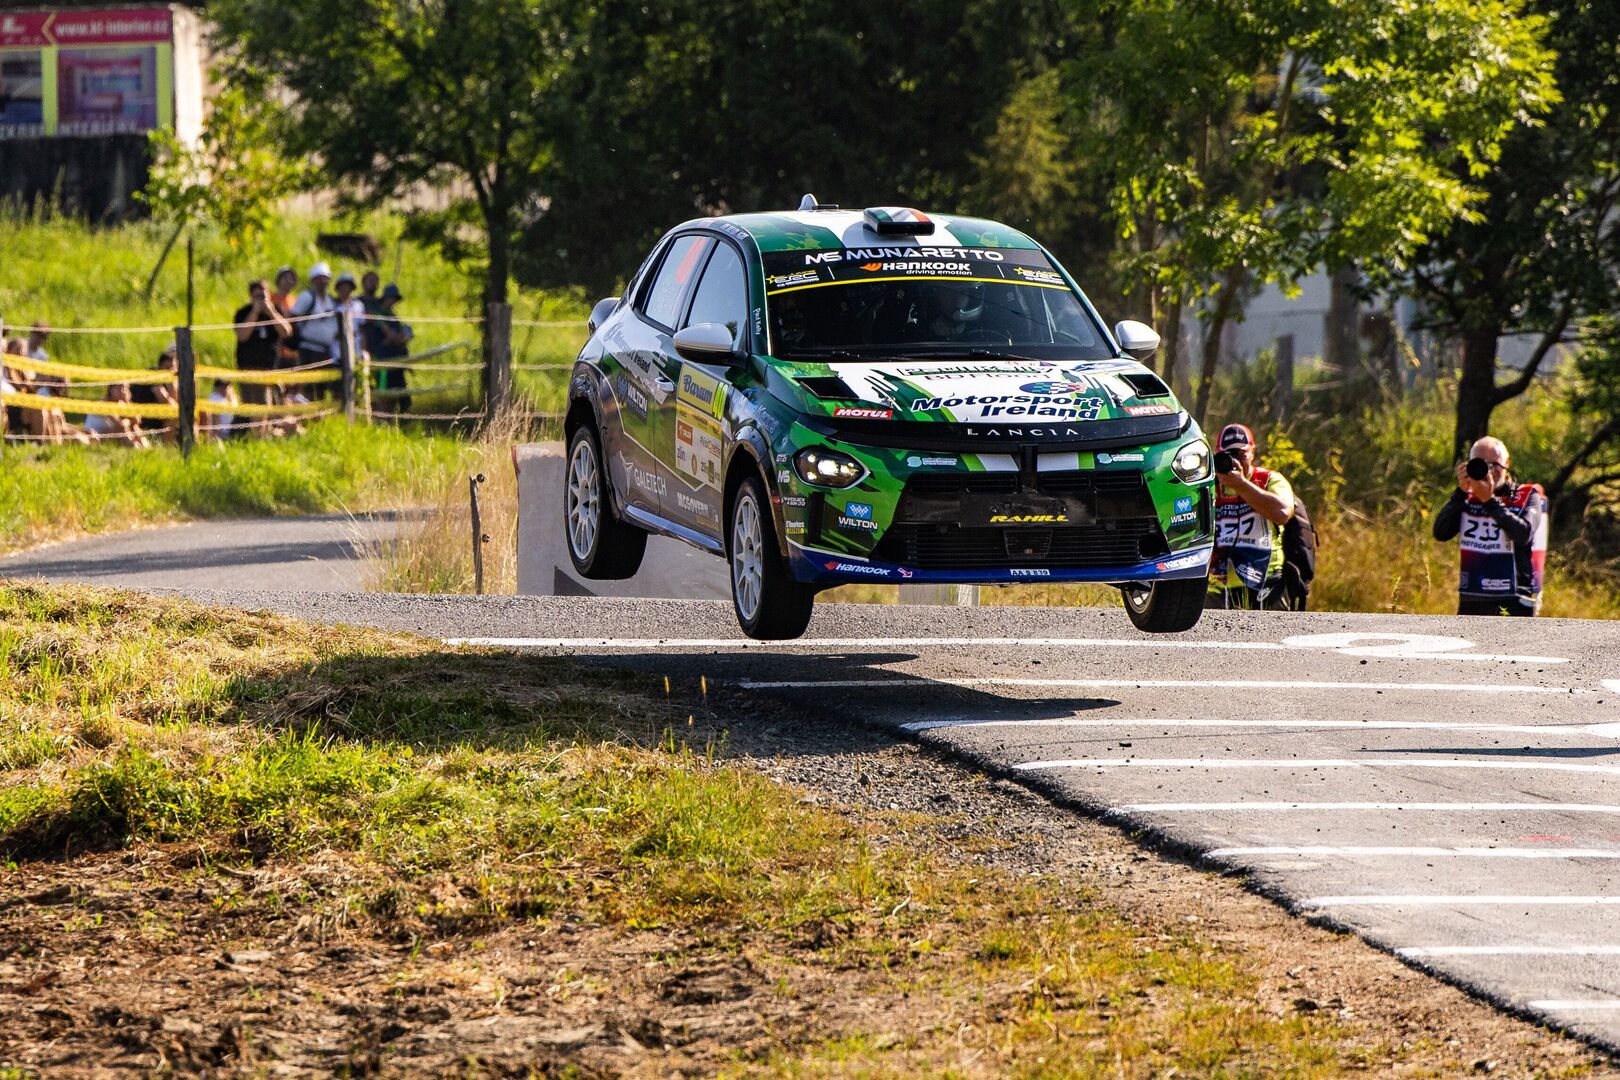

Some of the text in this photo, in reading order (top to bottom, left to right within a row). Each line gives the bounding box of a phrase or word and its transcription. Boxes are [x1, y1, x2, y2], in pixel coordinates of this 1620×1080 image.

[805, 248, 1004, 265] MS MUNARETTO
[912, 395, 1102, 410] Motorsport
[836, 409, 889, 418] MOTUL
[980, 405, 1099, 420] Ireland
[1129, 406, 1171, 415] MOTUL
[967, 428, 1079, 436] LANCIA
[633, 468, 668, 497] GALETECH
[838, 516, 878, 530] WILTON
[1170, 511, 1197, 524] WILTON
